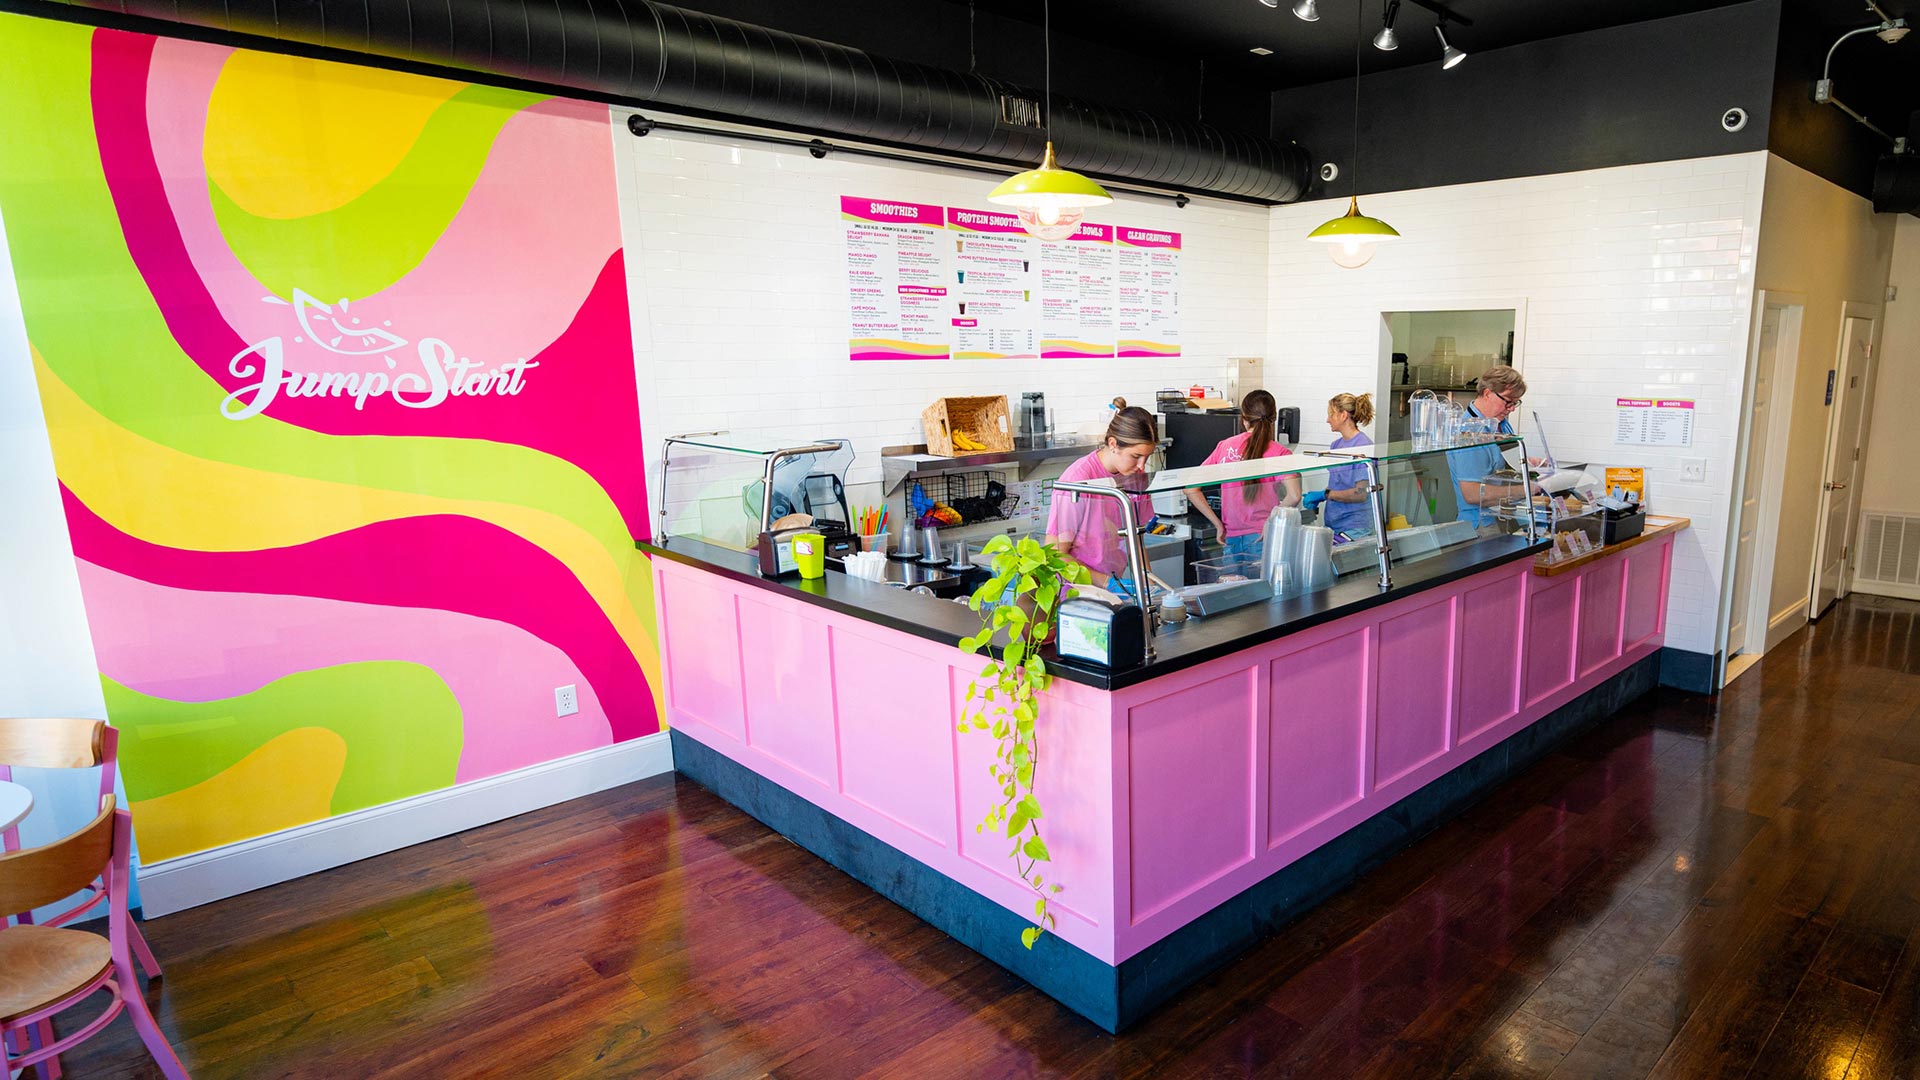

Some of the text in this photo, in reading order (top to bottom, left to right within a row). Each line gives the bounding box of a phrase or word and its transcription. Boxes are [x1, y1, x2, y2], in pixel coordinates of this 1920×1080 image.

[870, 203, 918, 218] SMOOTHIES
[957, 212, 988, 224] PROTEIN
[1083, 226, 1103, 237] BOWLS
[1128, 231, 1171, 244] CLEAN CRAVINGS
